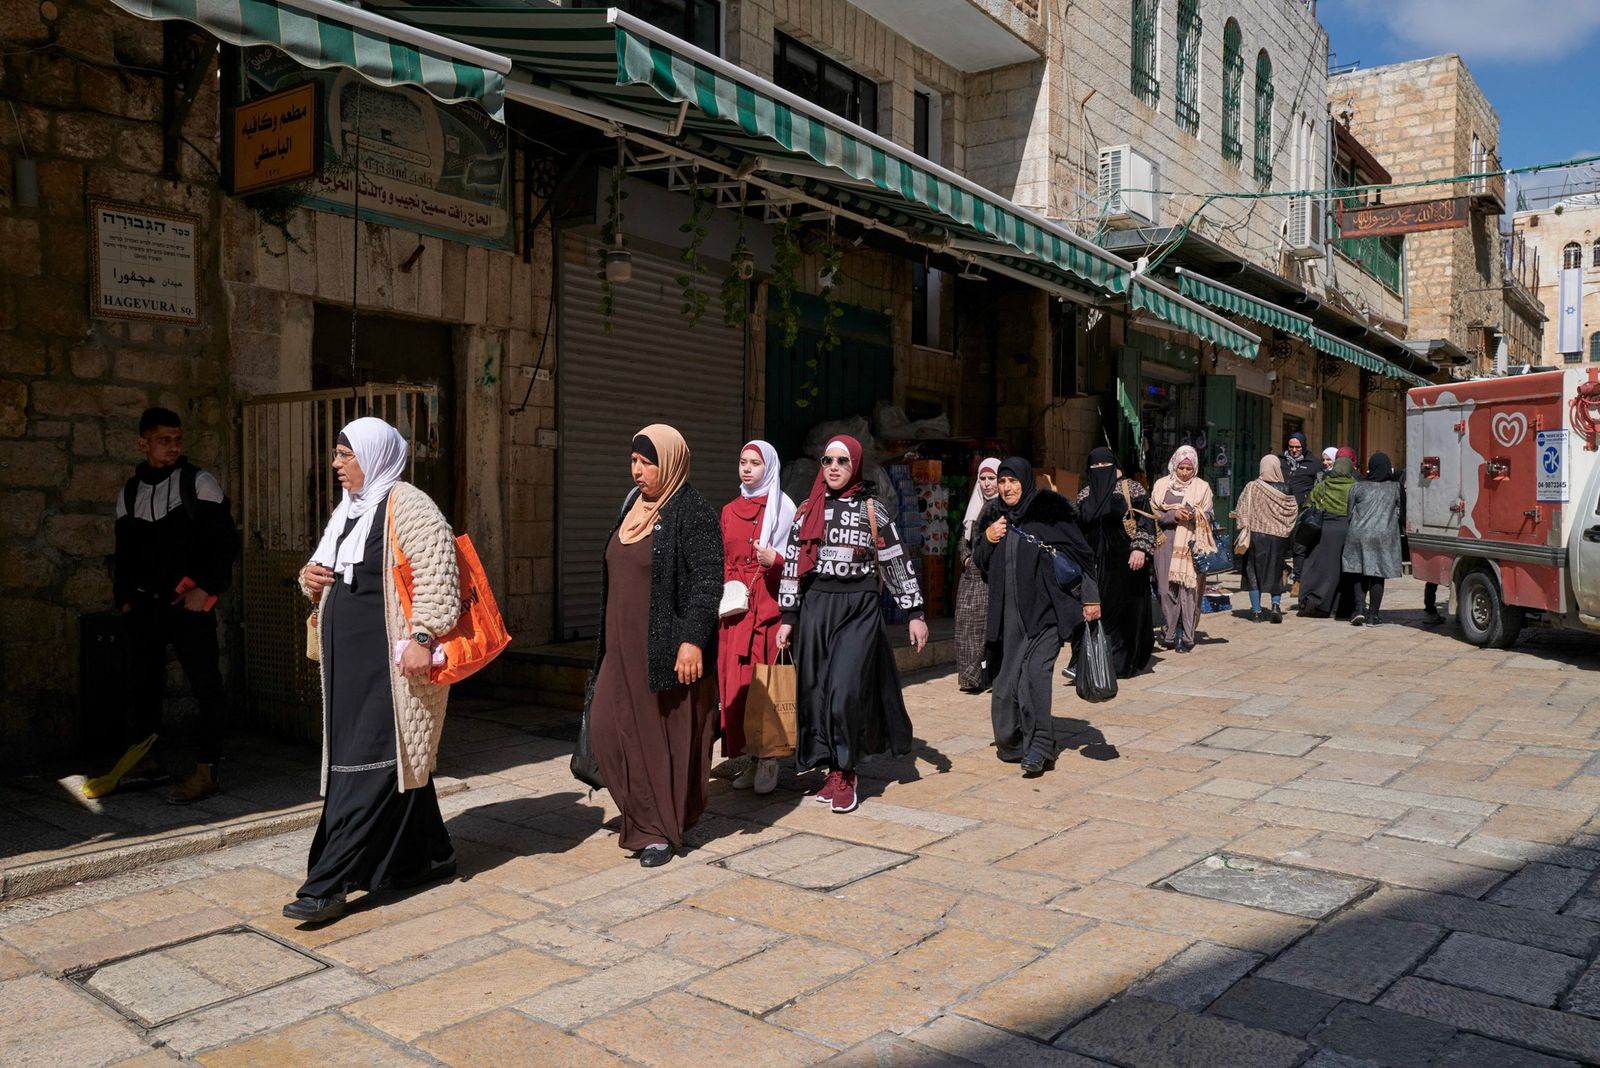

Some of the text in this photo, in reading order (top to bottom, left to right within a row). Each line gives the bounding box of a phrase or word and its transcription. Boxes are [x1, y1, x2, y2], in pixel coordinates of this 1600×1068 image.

[241, 103, 307, 139] مطعم وكافيه
[254, 135, 292, 169] الباسطي
[448, 205, 468, 223] رأفت
[467, 213, 492, 227] الحاج
[162, 278, 183, 288] ميدان
[103, 294, 194, 316] HAGEVURA SQ.
